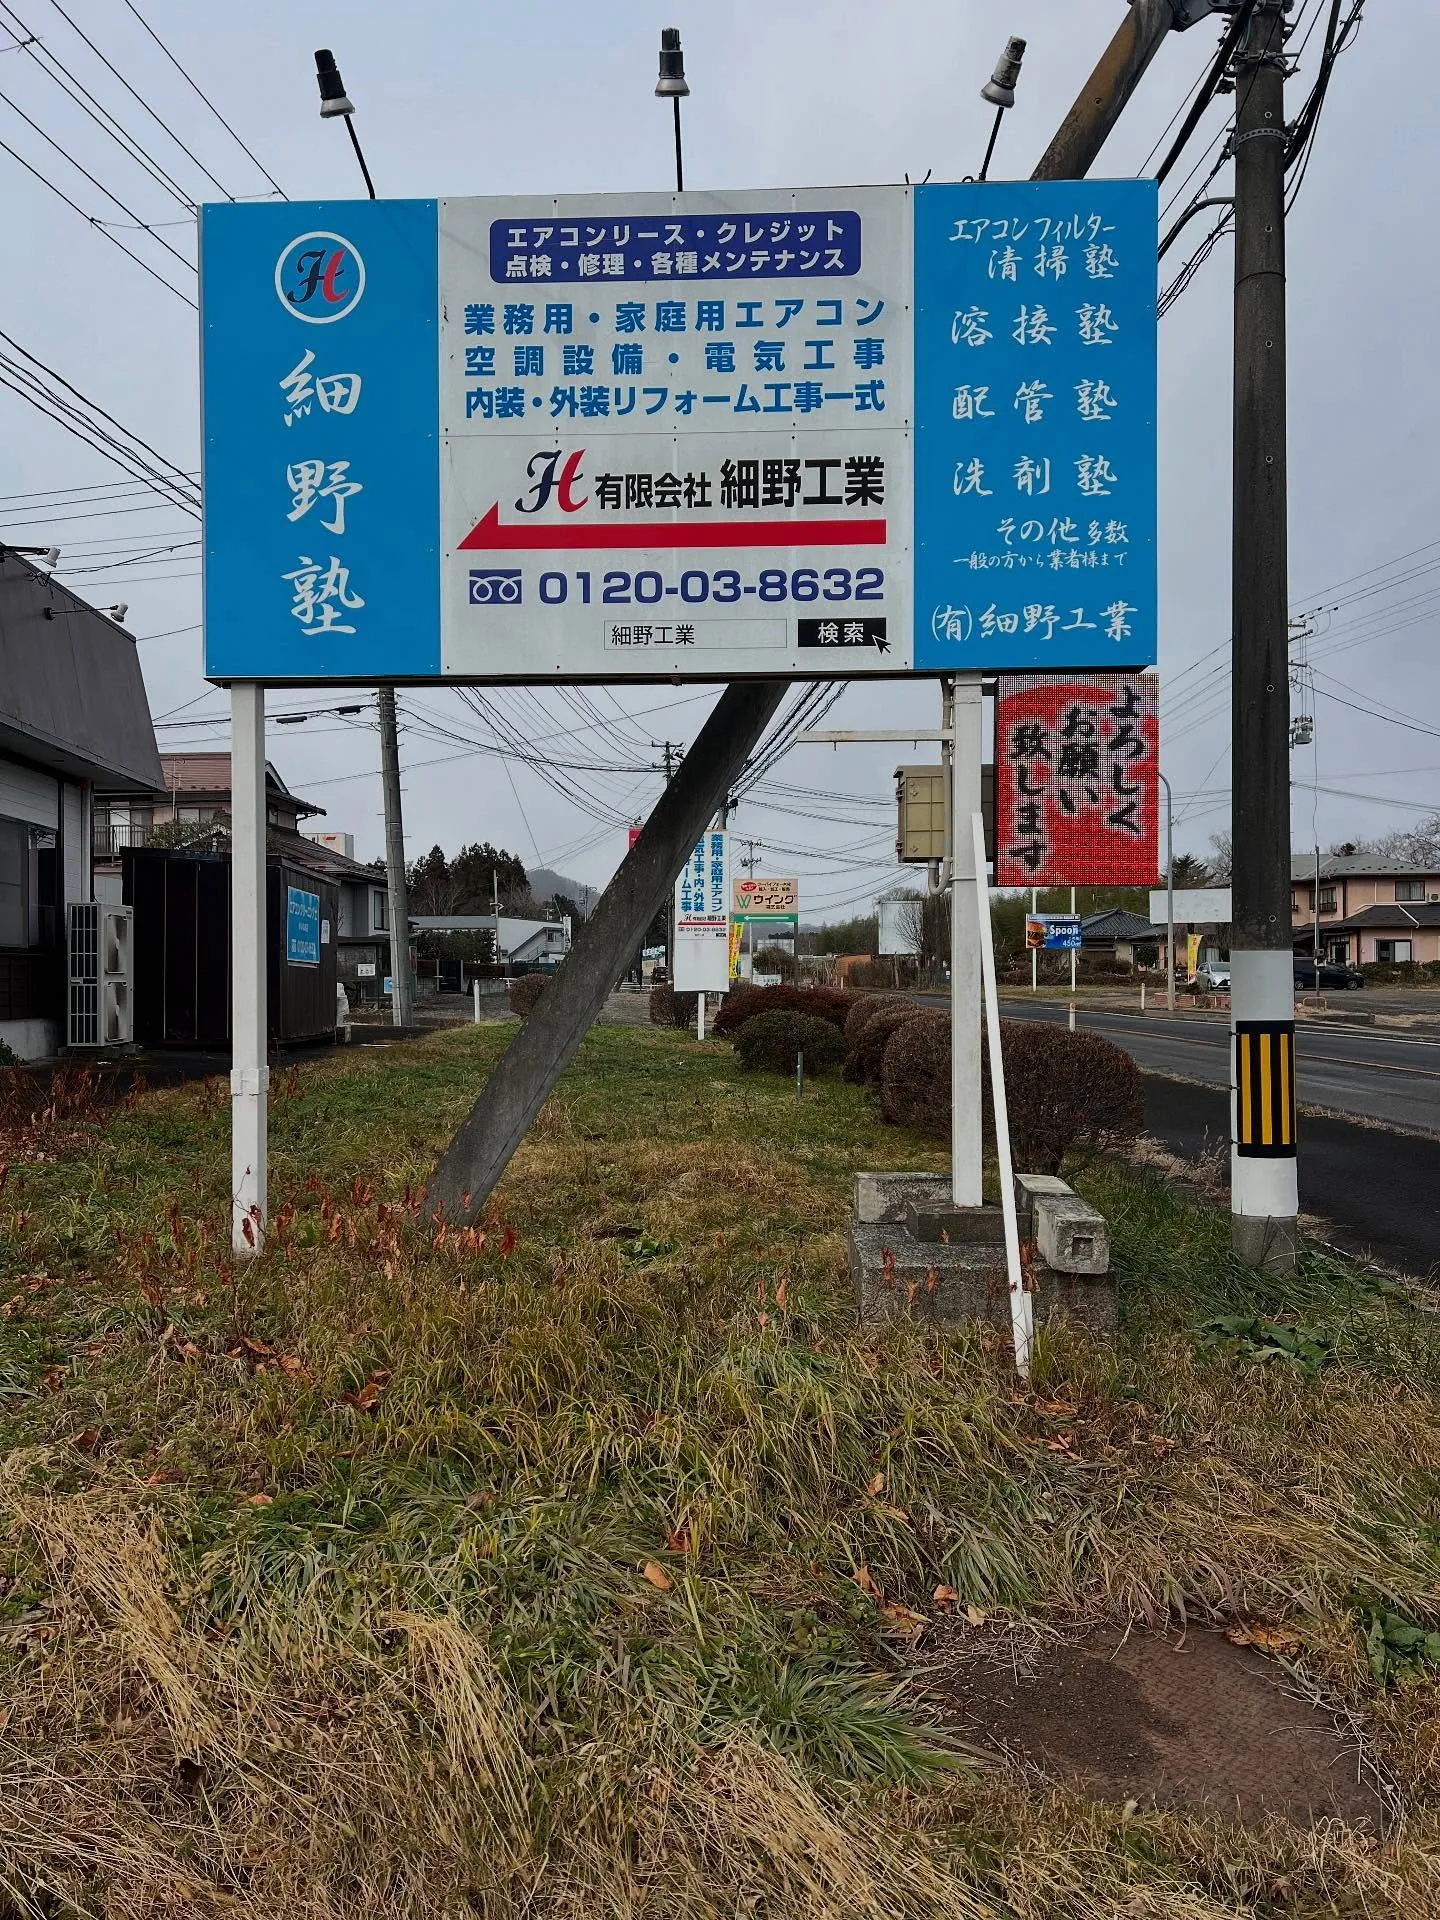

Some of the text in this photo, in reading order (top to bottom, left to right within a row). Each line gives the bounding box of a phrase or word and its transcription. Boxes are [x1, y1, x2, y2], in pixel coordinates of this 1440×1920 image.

[506, 218, 846, 249] エアコンリース・クレジット
[948, 211, 1117, 245] エアコンフィルター
[505, 248, 846, 278] 点検・修理・各種メンテナンス
[987, 243, 1120, 282] 清掃塾
[463, 297, 886, 336] 業務用・家庭用エアコン
[951, 302, 1120, 347] 溶接塾
[463, 337, 886, 377] 空調設備・電気工事
[464, 380, 886, 420] 内装・外装リフォーム工事一式
[951, 379, 1119, 425] 配管塾
[278, 348, 366, 636] 細野塾
[594, 472, 712, 510] 有限会社
[719, 455, 886, 509] 細野工業
[952, 454, 1119, 497] 洗剤塾
[952, 549, 1128, 571] 一般の方から業者様まで
[538, 567, 885, 605] 0120-03-8632
[610, 623, 696, 647] 細野工業
[817, 621, 866, 644] 検索
[931, 600, 1139, 643] (有)細野工業
[1057, 704, 1101, 814] お願い
[1108, 684, 1148, 835] よろしく
[1005, 722, 1053, 873] 致します
[711, 833, 723, 912] 業務用・家庭用エアコン
[753, 893, 798, 905] ウイング
